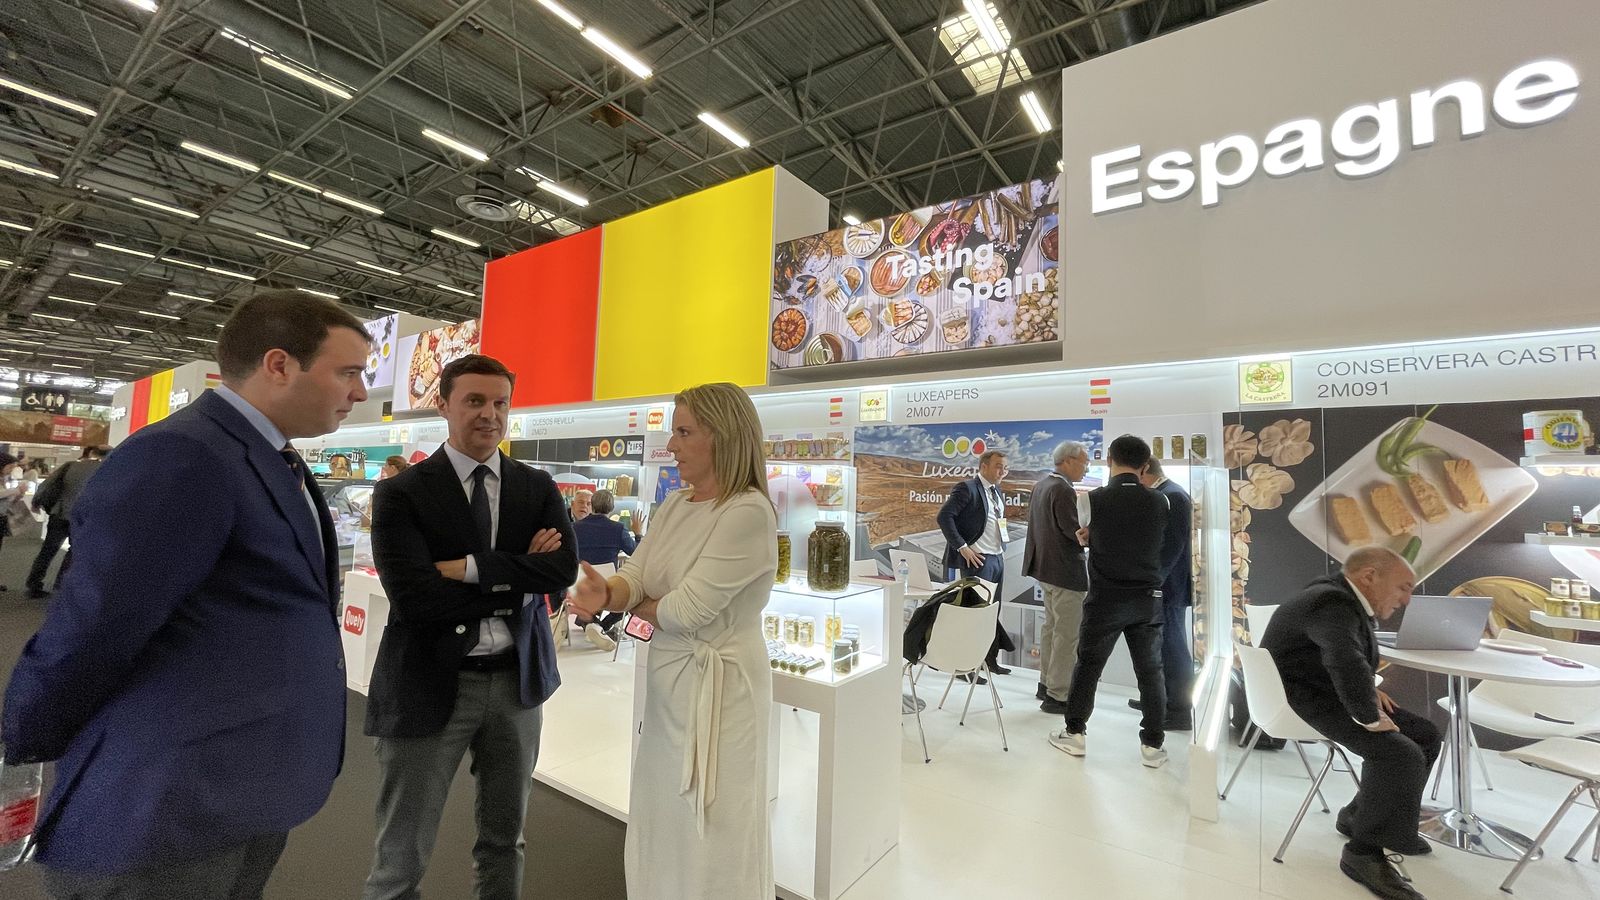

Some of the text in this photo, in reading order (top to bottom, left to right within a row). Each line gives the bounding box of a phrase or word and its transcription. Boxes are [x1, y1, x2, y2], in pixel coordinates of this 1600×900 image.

[1090, 59, 1580, 214] Espagne
[885, 242, 994, 280] Tasting
[952, 266, 1046, 308] Spain
[1317, 344, 1597, 378] CONSERVERA CASTR
[906, 388, 979, 403] LUXEAPERS
[1317, 381, 1390, 398] 2M091
[906, 406, 944, 418] 2M077
[909, 490, 943, 504] Pasión
[345, 610, 364, 631] Quely
